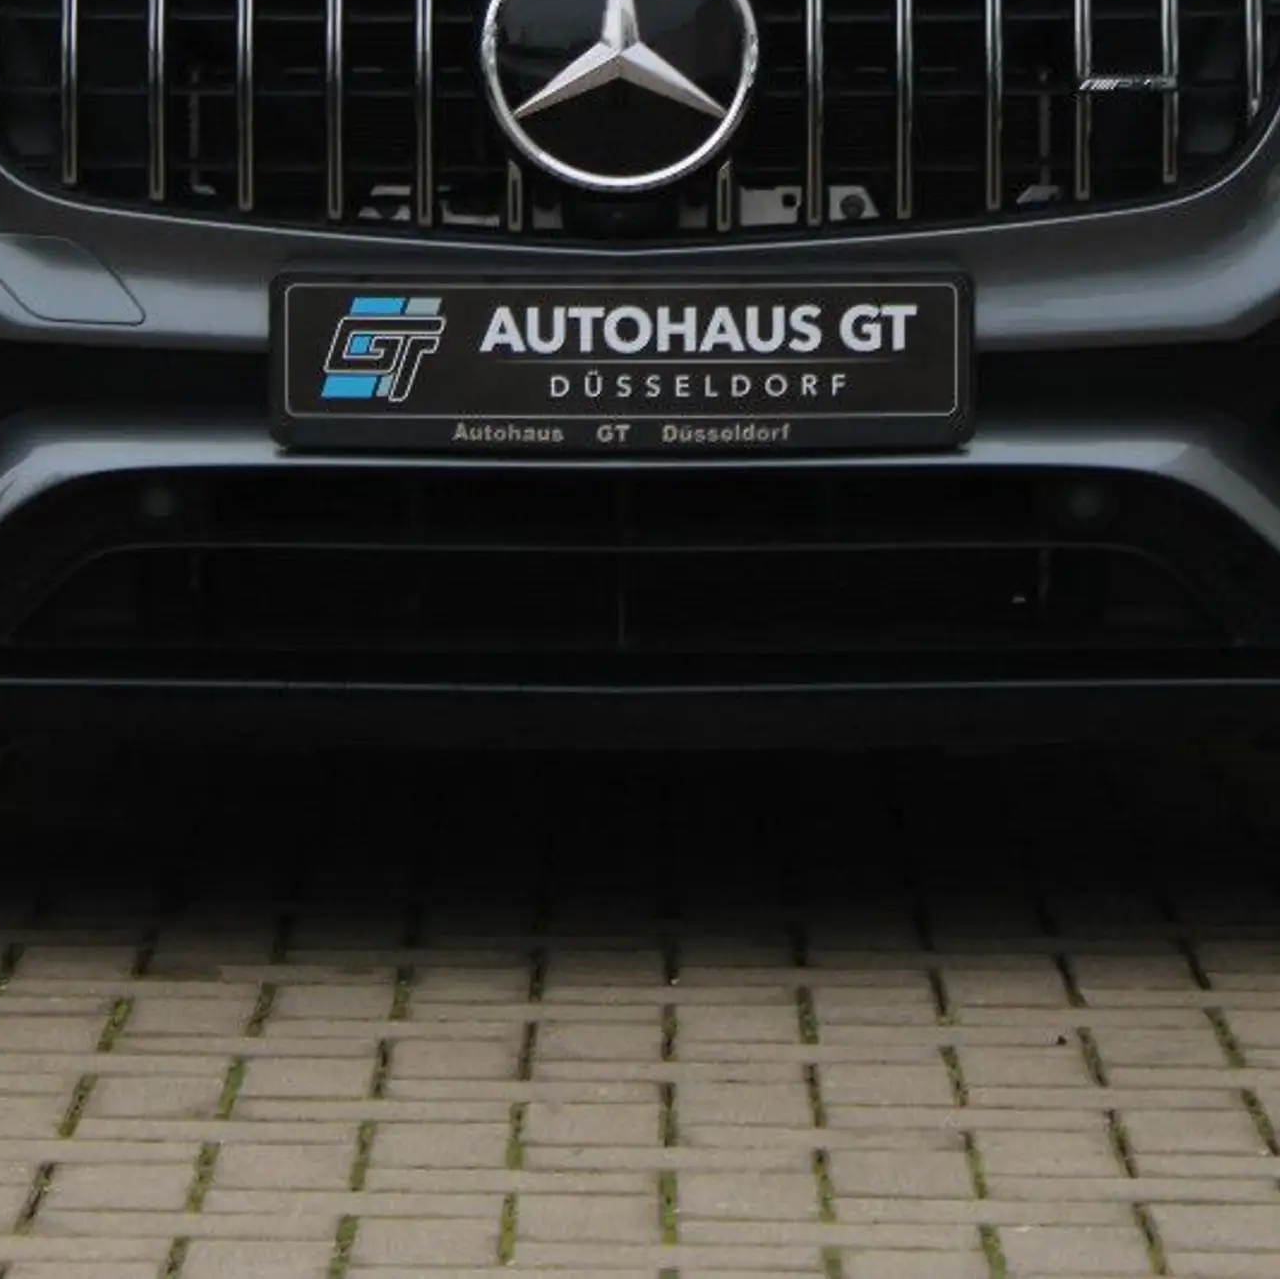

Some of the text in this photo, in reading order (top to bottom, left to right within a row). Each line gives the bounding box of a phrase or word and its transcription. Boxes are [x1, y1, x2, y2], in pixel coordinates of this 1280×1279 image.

[479, 304, 918, 354] AUTOHAUS GT
[549, 370, 847, 398] DÜSSELDORF
[452, 423, 791, 442] Autohaus GT Düsseldorf
